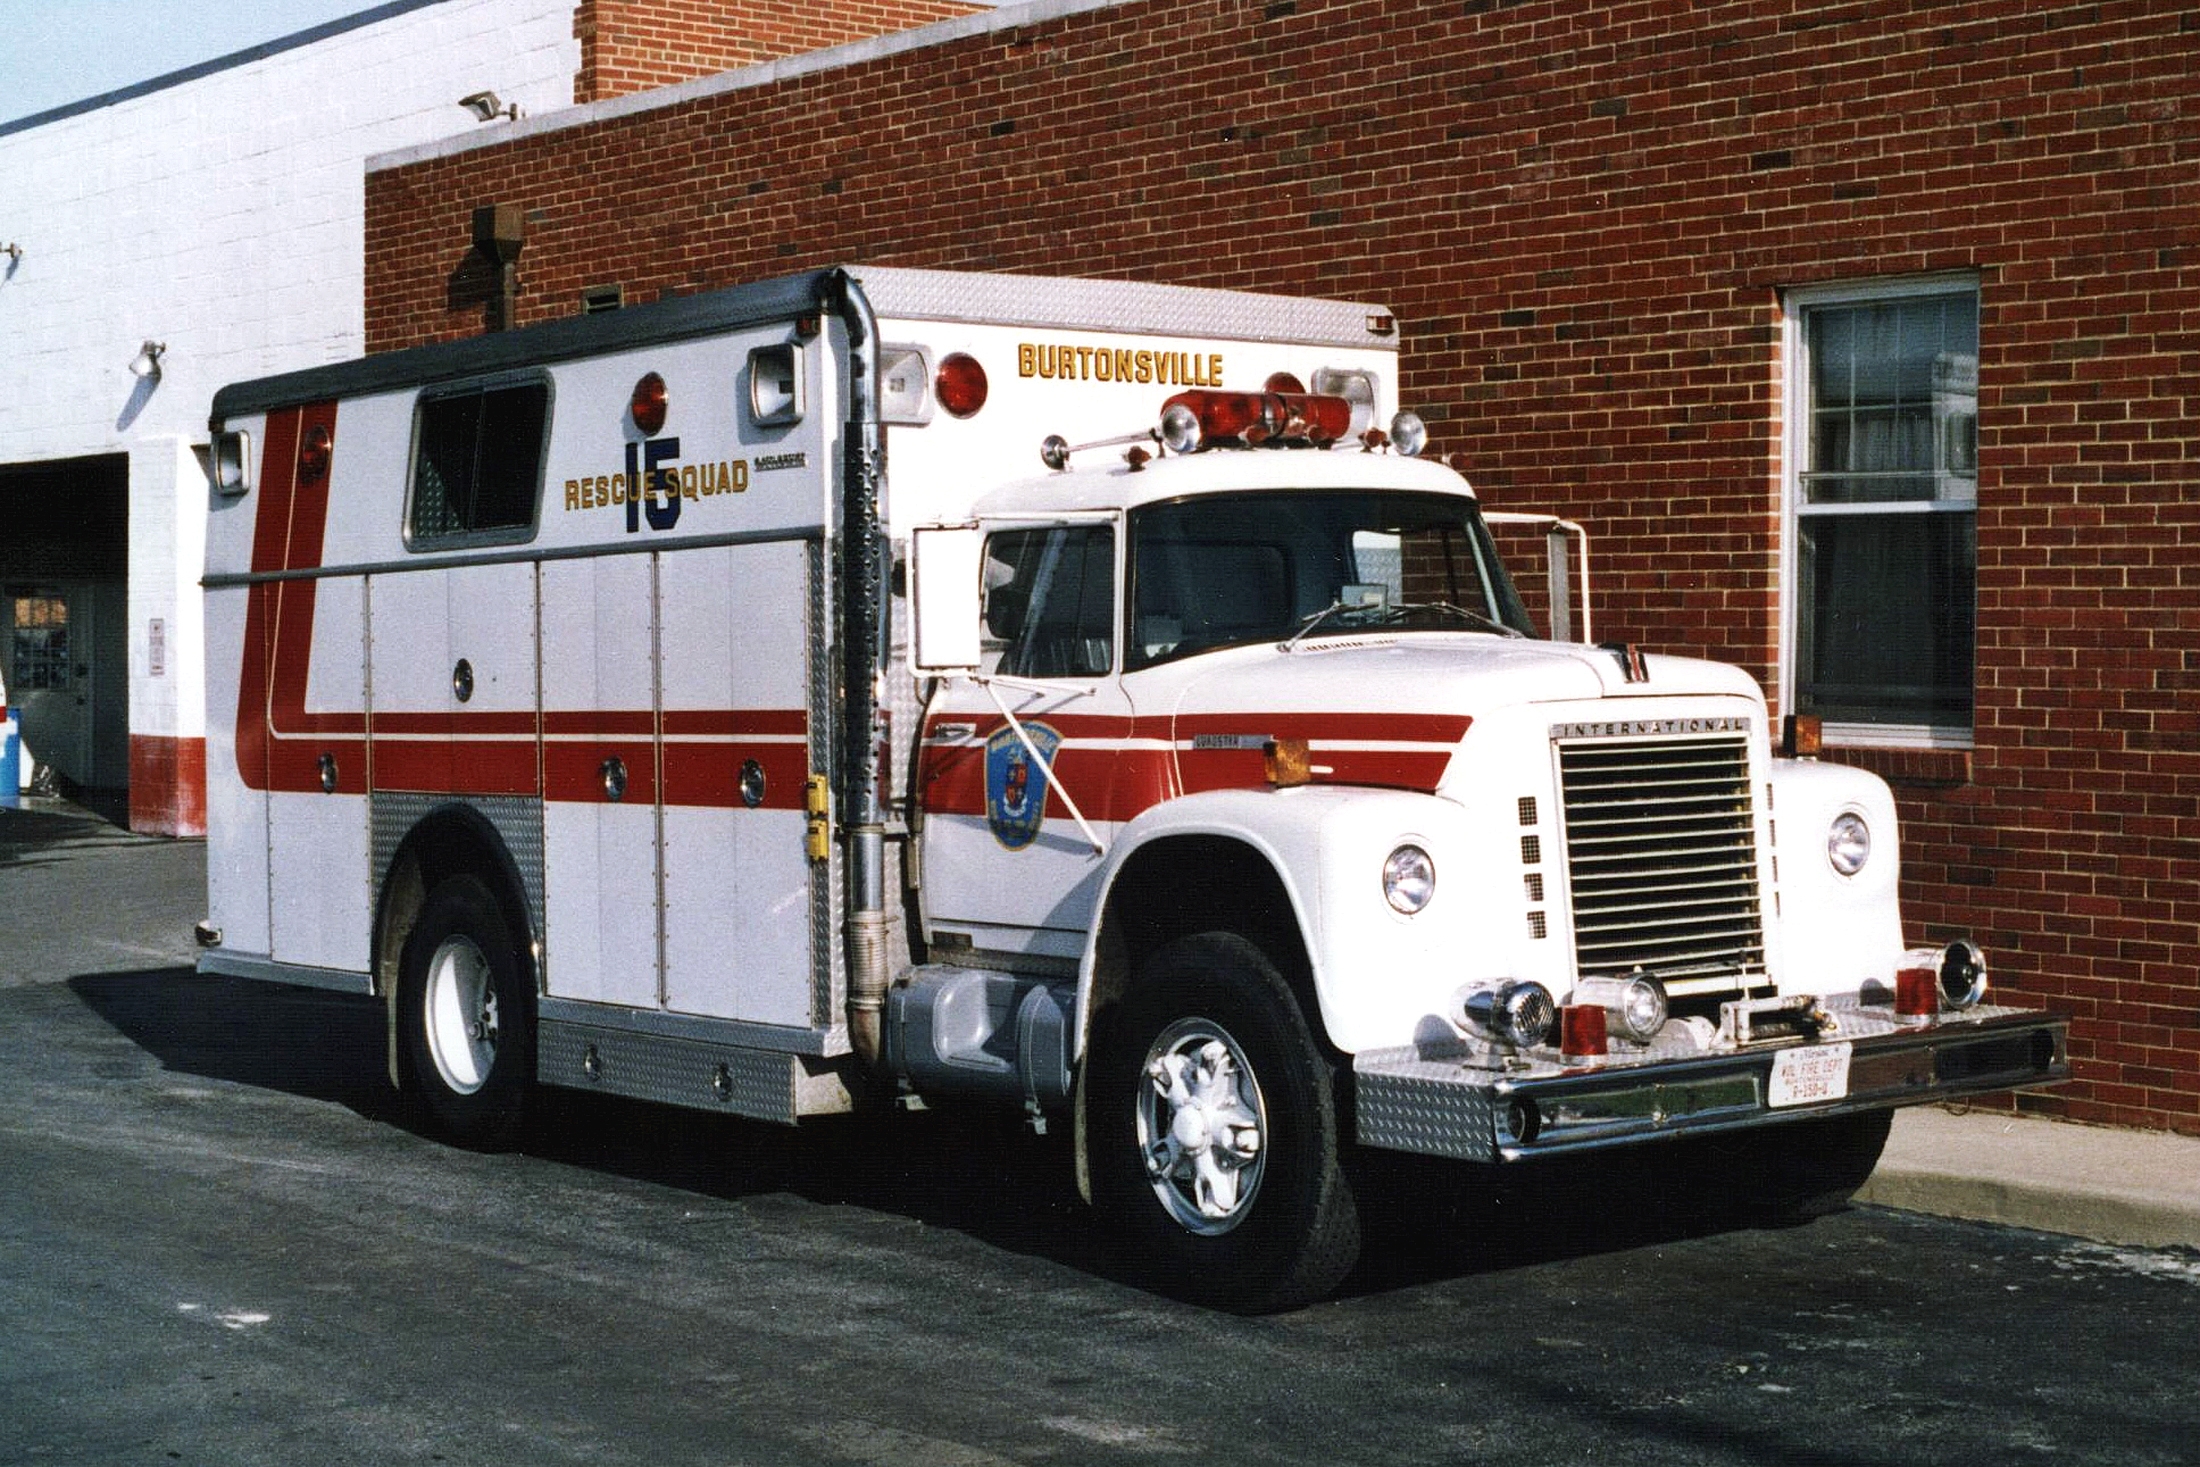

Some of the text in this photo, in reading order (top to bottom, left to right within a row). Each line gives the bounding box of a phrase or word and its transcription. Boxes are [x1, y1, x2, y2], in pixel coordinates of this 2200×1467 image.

[1018, 343, 1223, 387] BURTONSVILLE
[565, 471, 657, 511] RESCUE
[665, 459, 749, 502] SQUAD
[625, 437, 681, 533] 15
[1563, 720, 1743, 737] INTERNATIONAL
